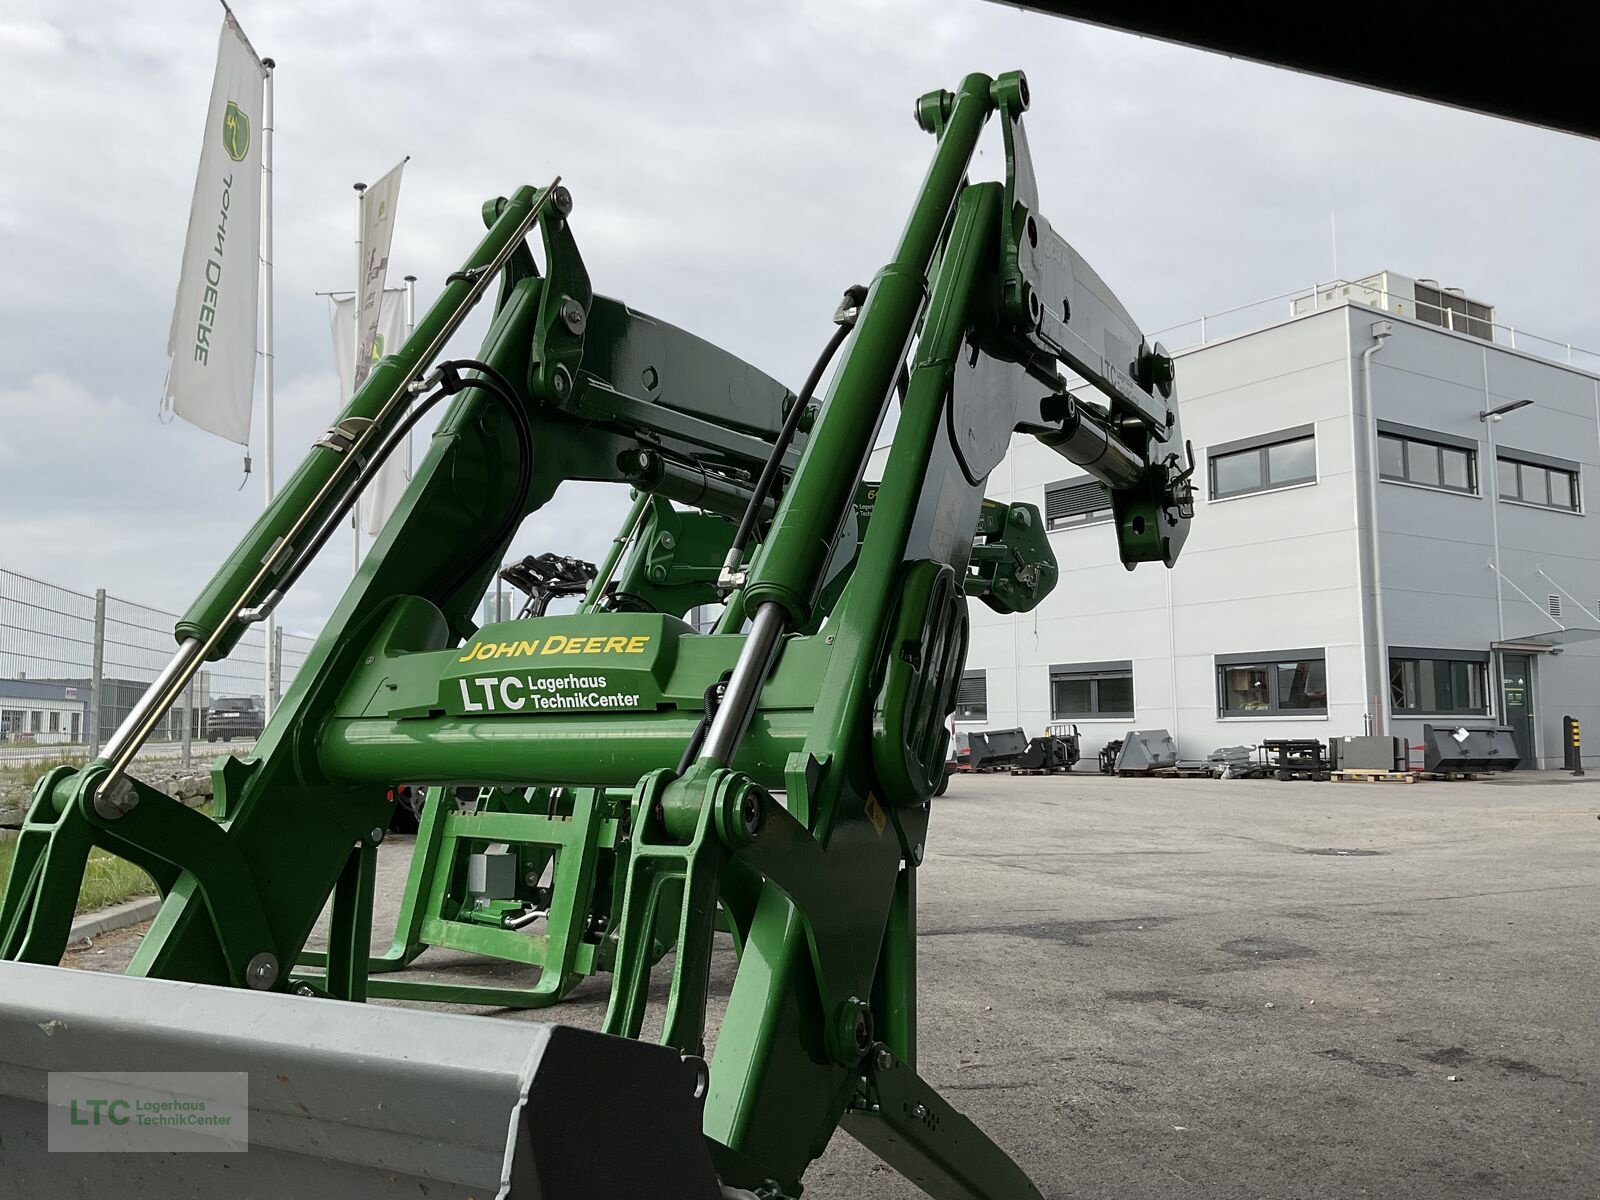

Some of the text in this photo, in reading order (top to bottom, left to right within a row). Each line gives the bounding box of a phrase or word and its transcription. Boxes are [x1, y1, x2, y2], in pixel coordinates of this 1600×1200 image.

[459, 635, 650, 662] JOHN DEERE
[459, 676, 526, 711] LTC
[528, 674, 607, 693] Lagerhaus
[531, 693, 640, 709] TechnikCenter
